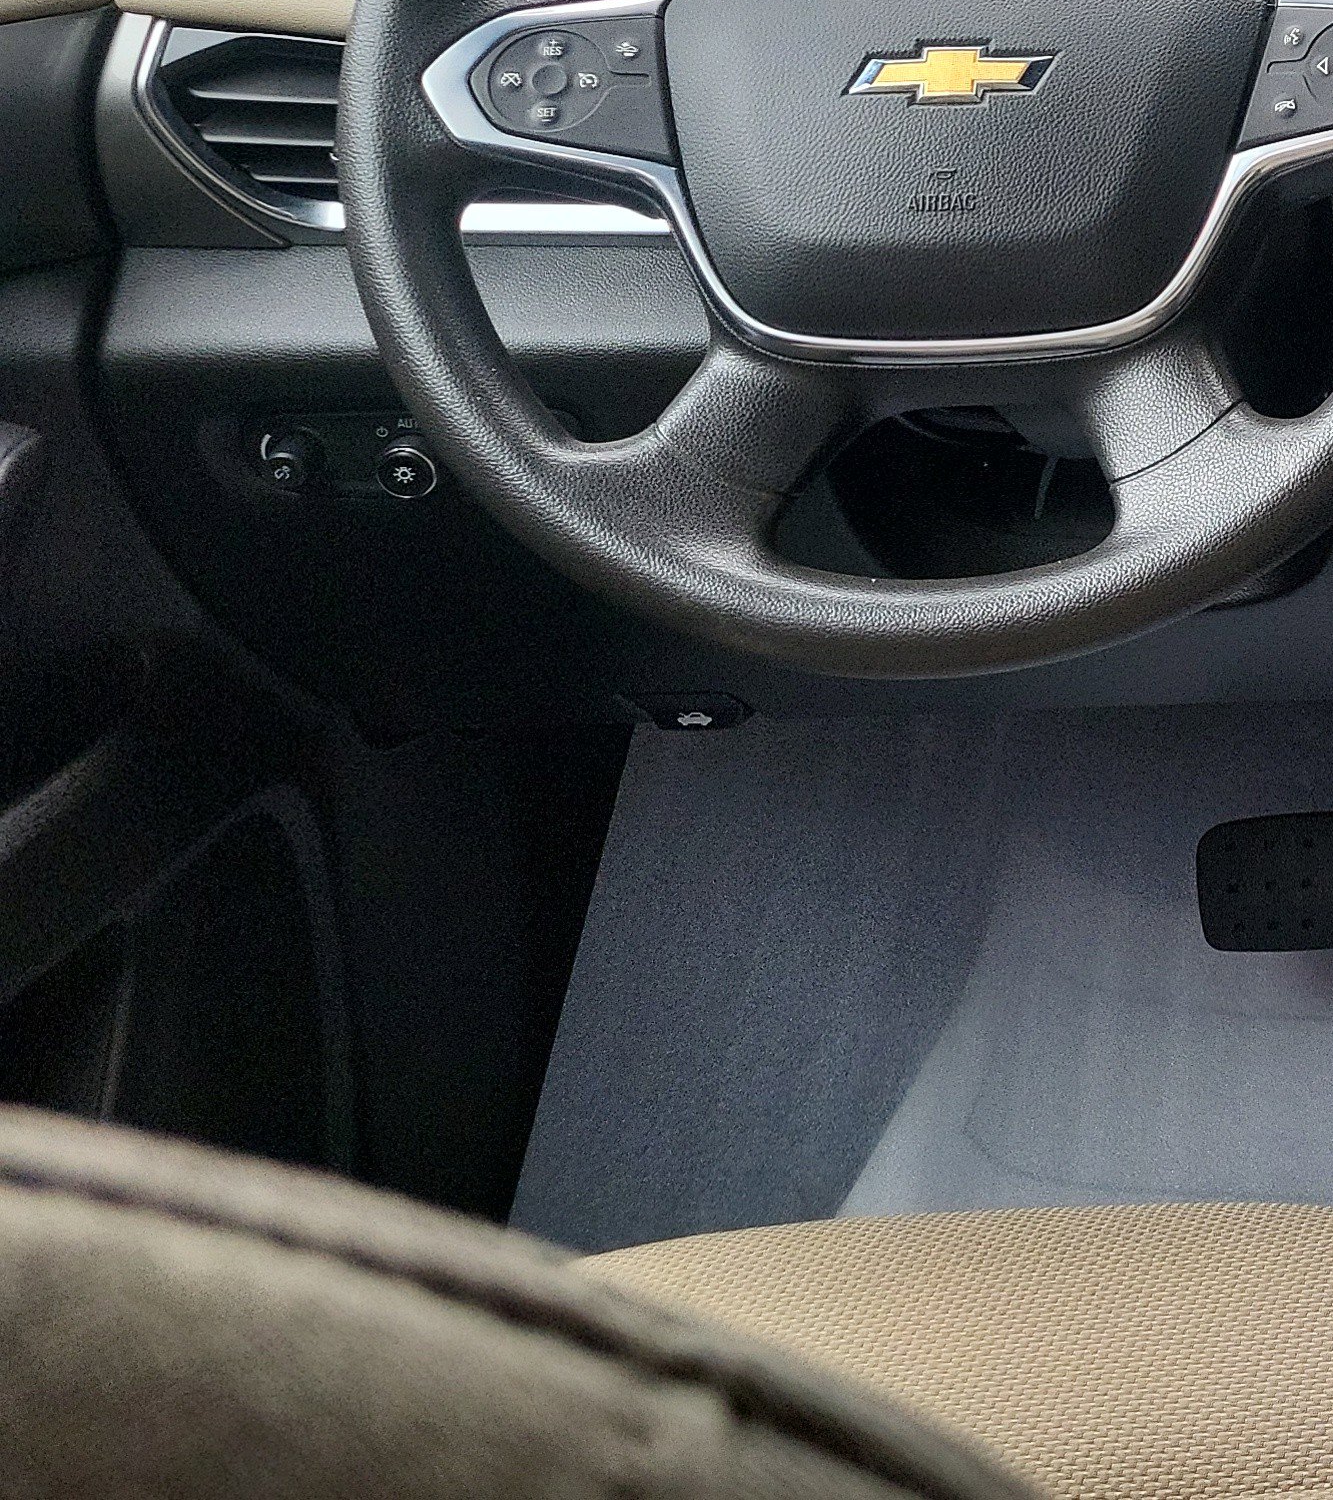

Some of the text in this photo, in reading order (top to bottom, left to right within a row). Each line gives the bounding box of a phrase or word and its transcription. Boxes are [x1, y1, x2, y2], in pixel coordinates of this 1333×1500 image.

[543, 46, 562, 56] RES
[537, 107, 557, 118] SET
[907, 192, 978, 212] AIRBAG
